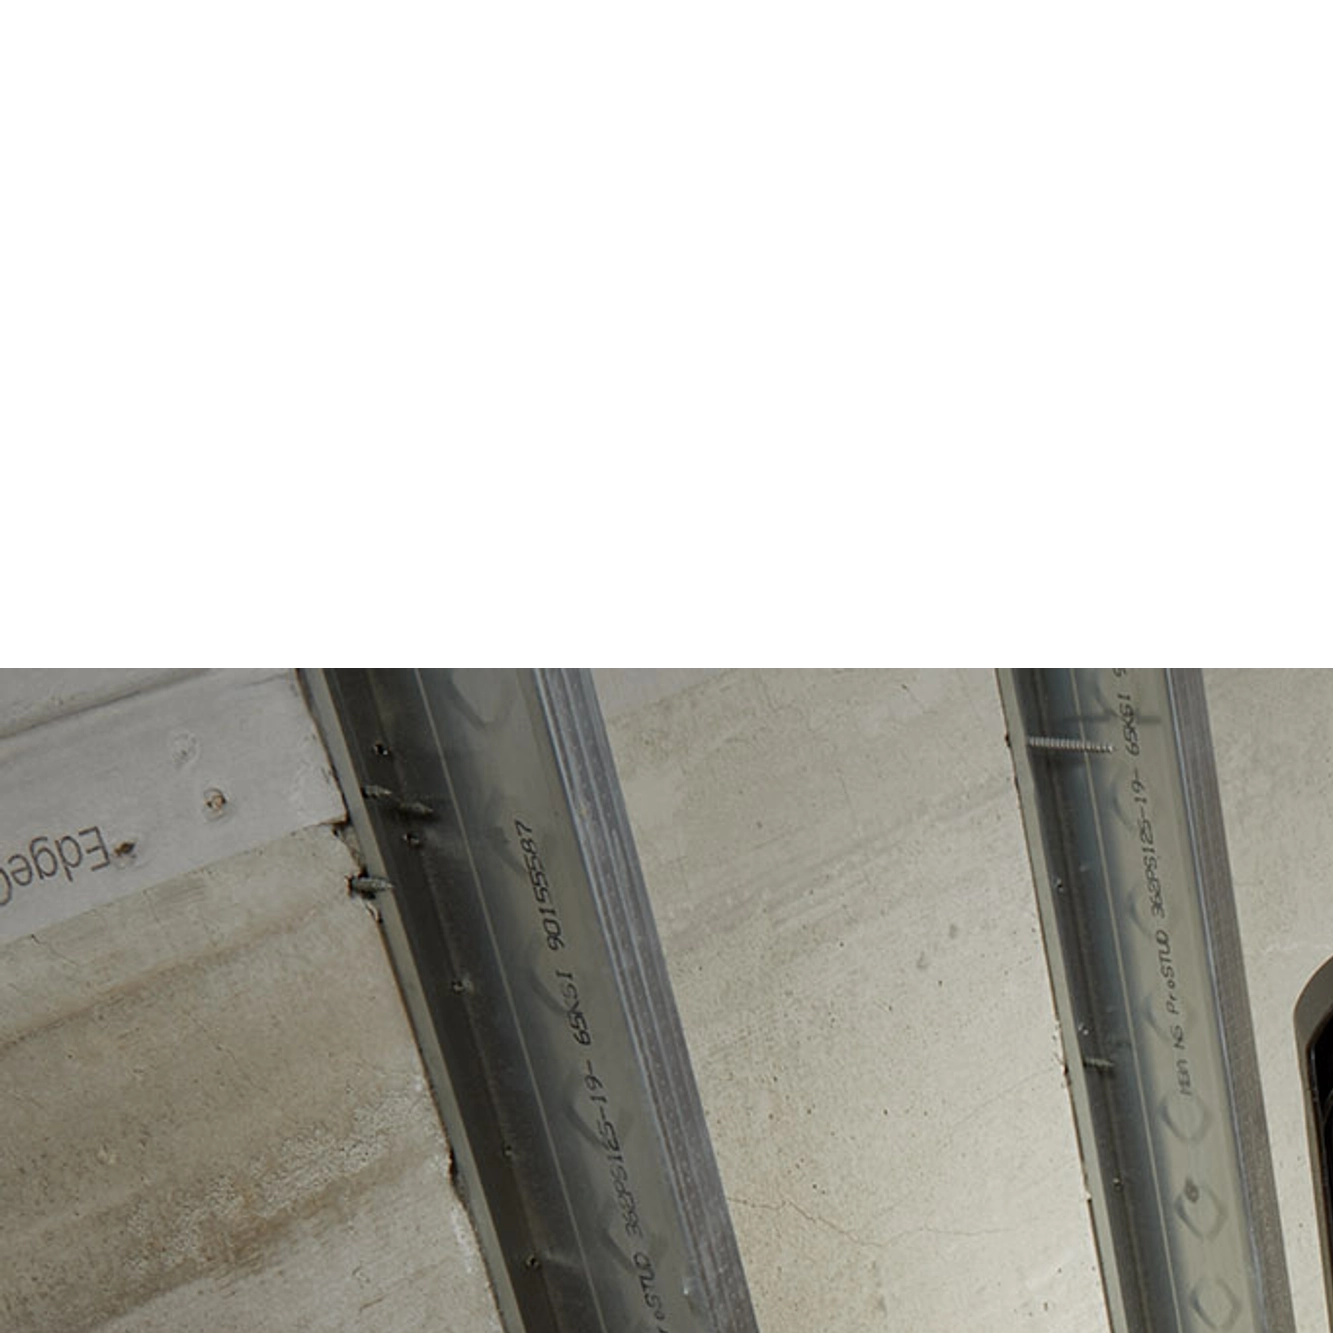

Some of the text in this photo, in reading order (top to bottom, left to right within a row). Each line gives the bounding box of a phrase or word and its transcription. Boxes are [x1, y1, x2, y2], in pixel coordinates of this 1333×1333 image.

[515, 819, 564, 953] 90155587
[556, 969, 592, 1047] 65KSI
[1155, 929, 1181, 1017] ProSTUD
